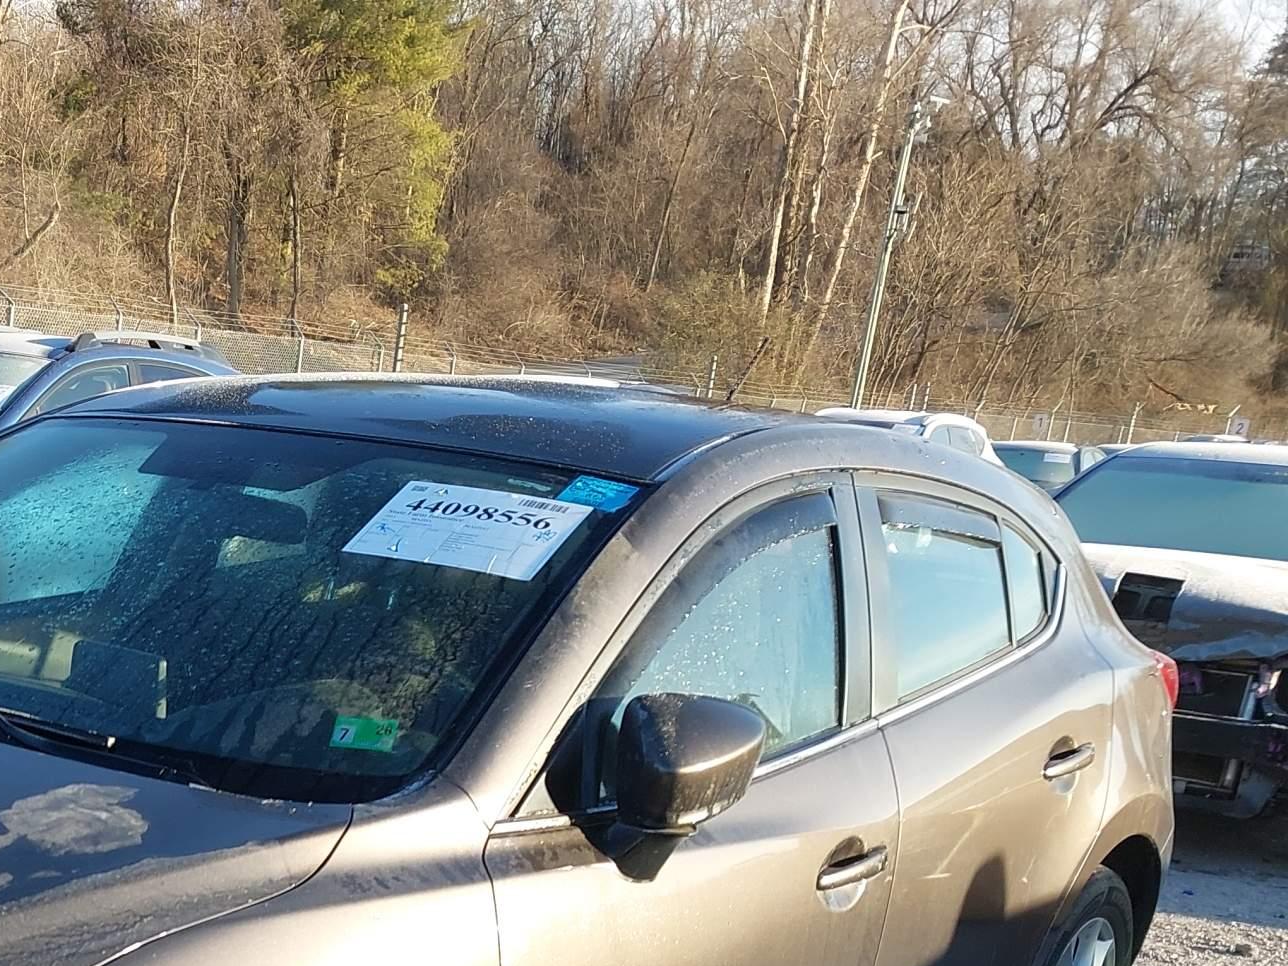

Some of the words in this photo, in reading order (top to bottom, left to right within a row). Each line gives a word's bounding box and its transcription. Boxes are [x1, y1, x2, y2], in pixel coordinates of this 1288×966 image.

[1037, 417, 1044, 428] 1
[1235, 422, 1245, 434] 2
[405, 498, 556, 530] 44098556
[339, 727, 350, 741] 7
